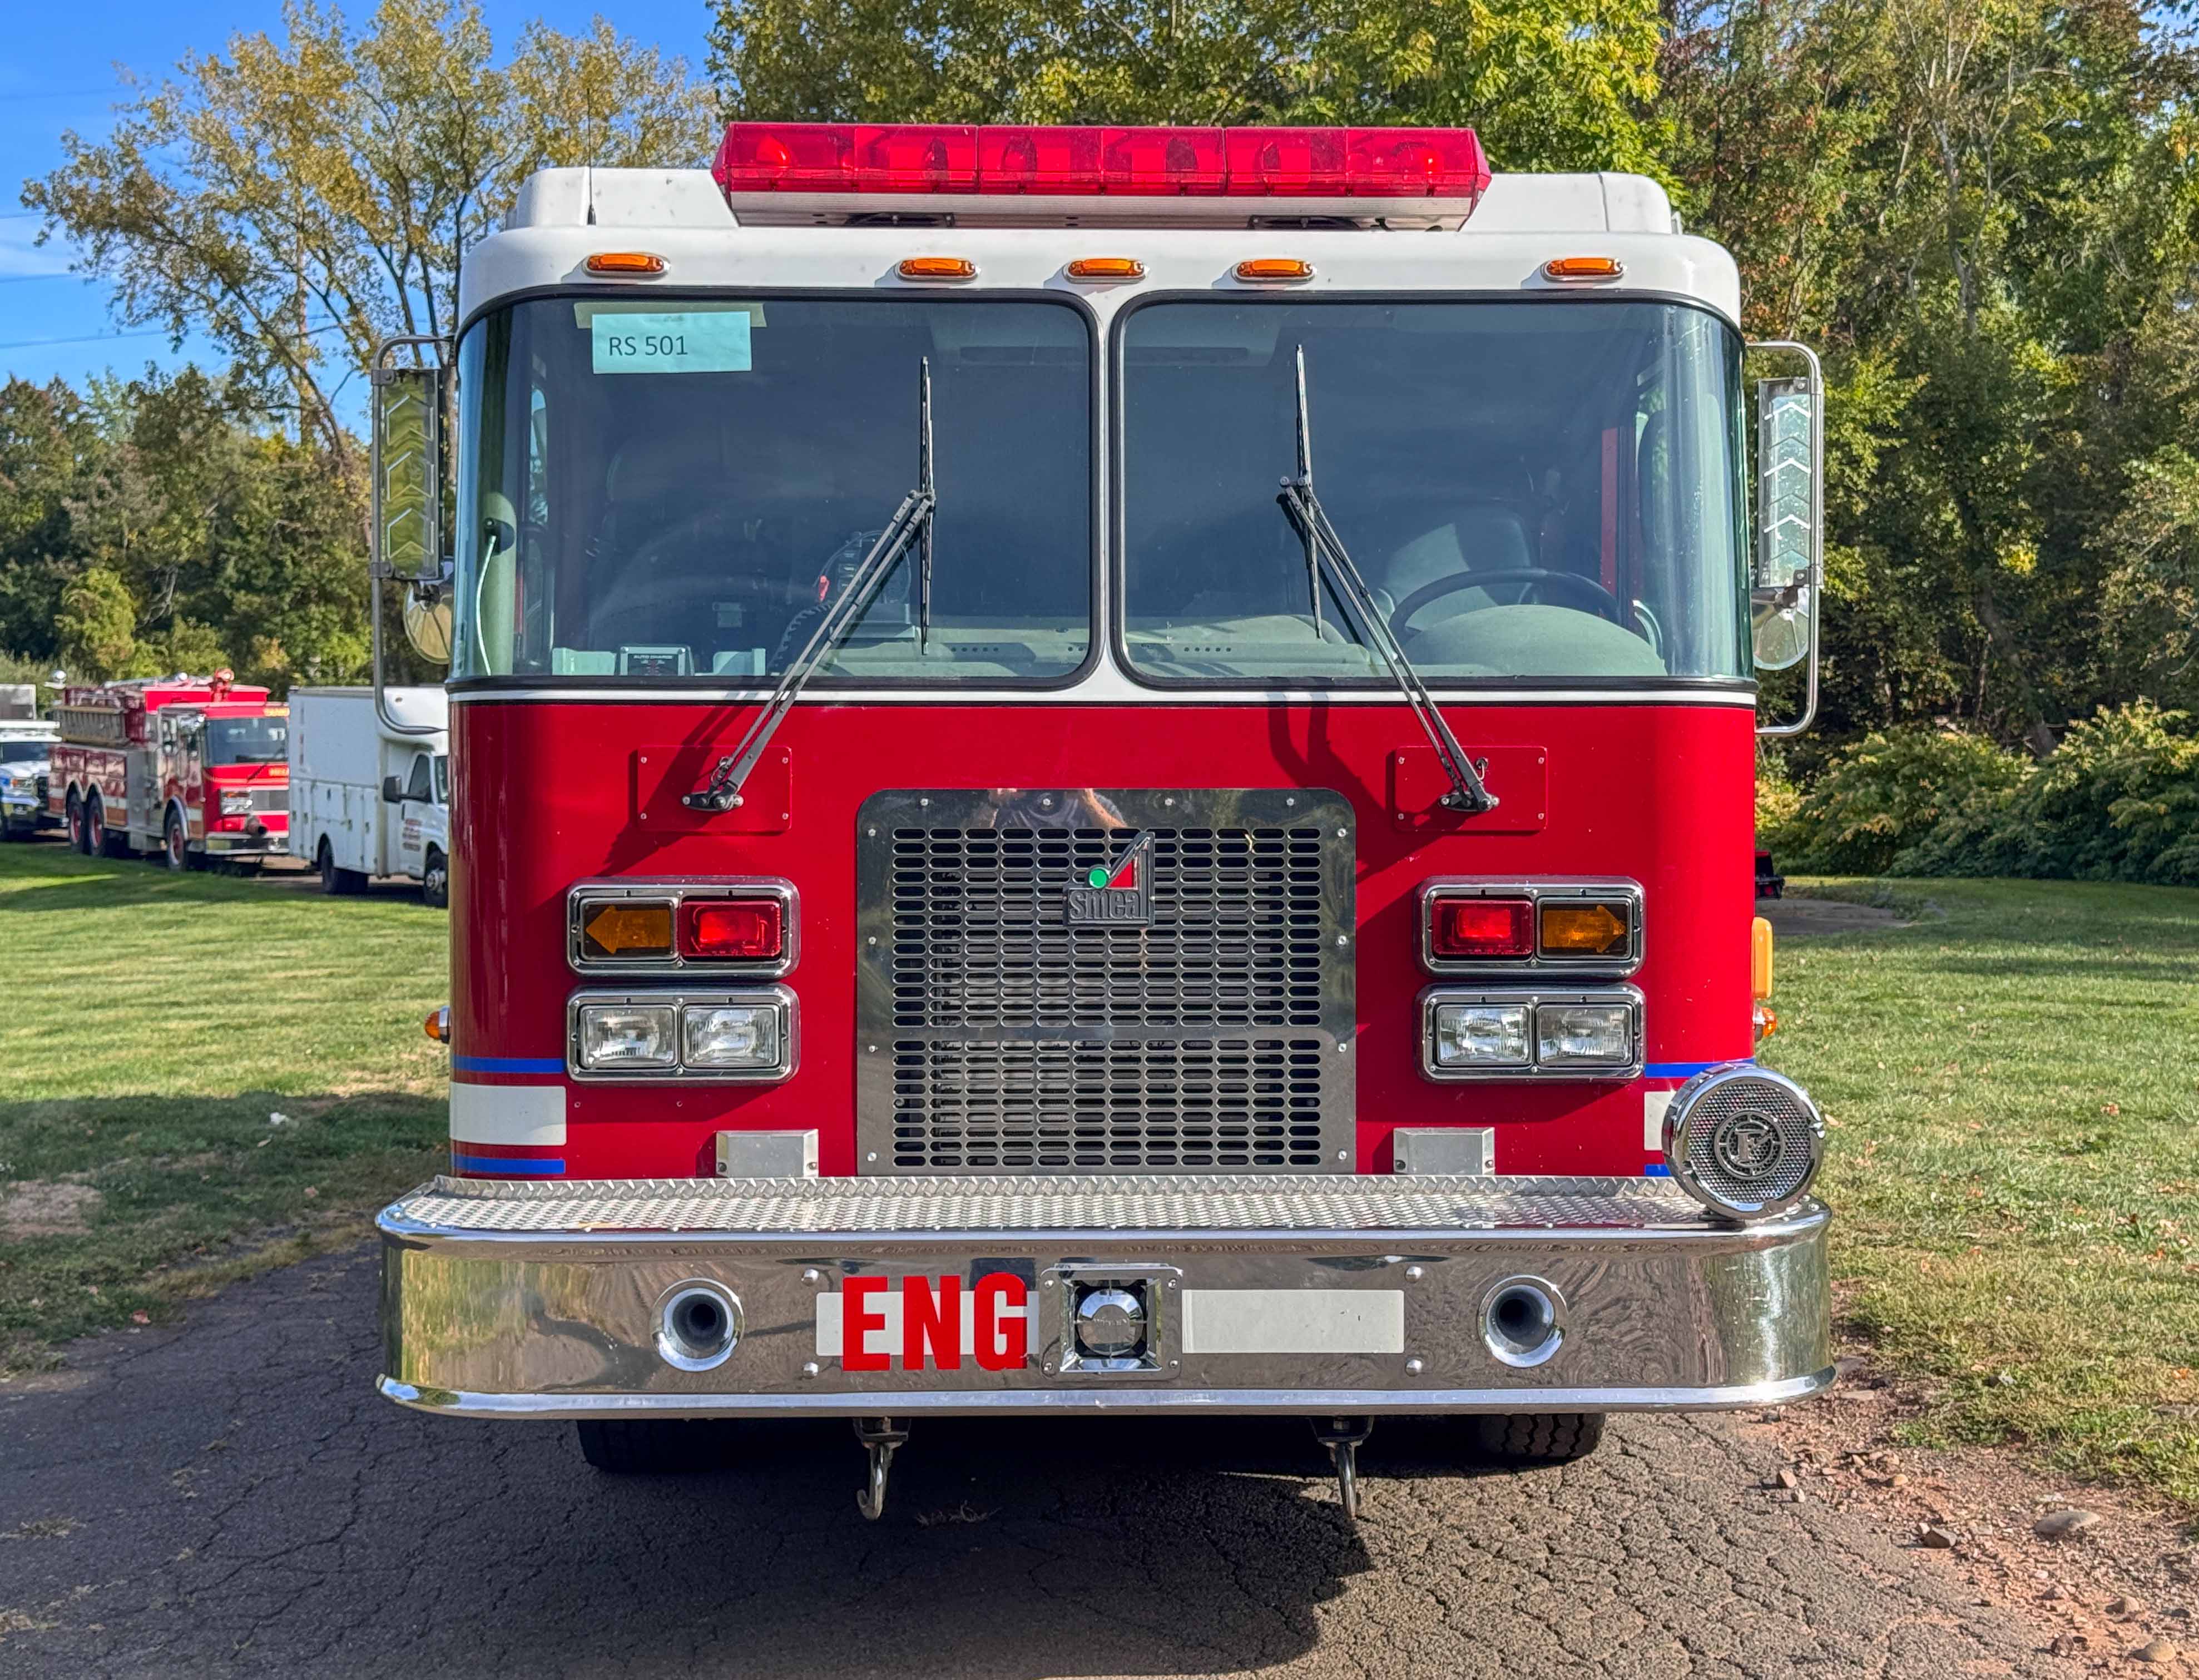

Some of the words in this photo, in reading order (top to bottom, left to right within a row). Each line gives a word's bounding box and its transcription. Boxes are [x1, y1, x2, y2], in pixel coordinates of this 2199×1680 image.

[608, 336, 637, 356] RS
[645, 335, 688, 356] 501
[843, 1272, 1027, 1371] ENG
